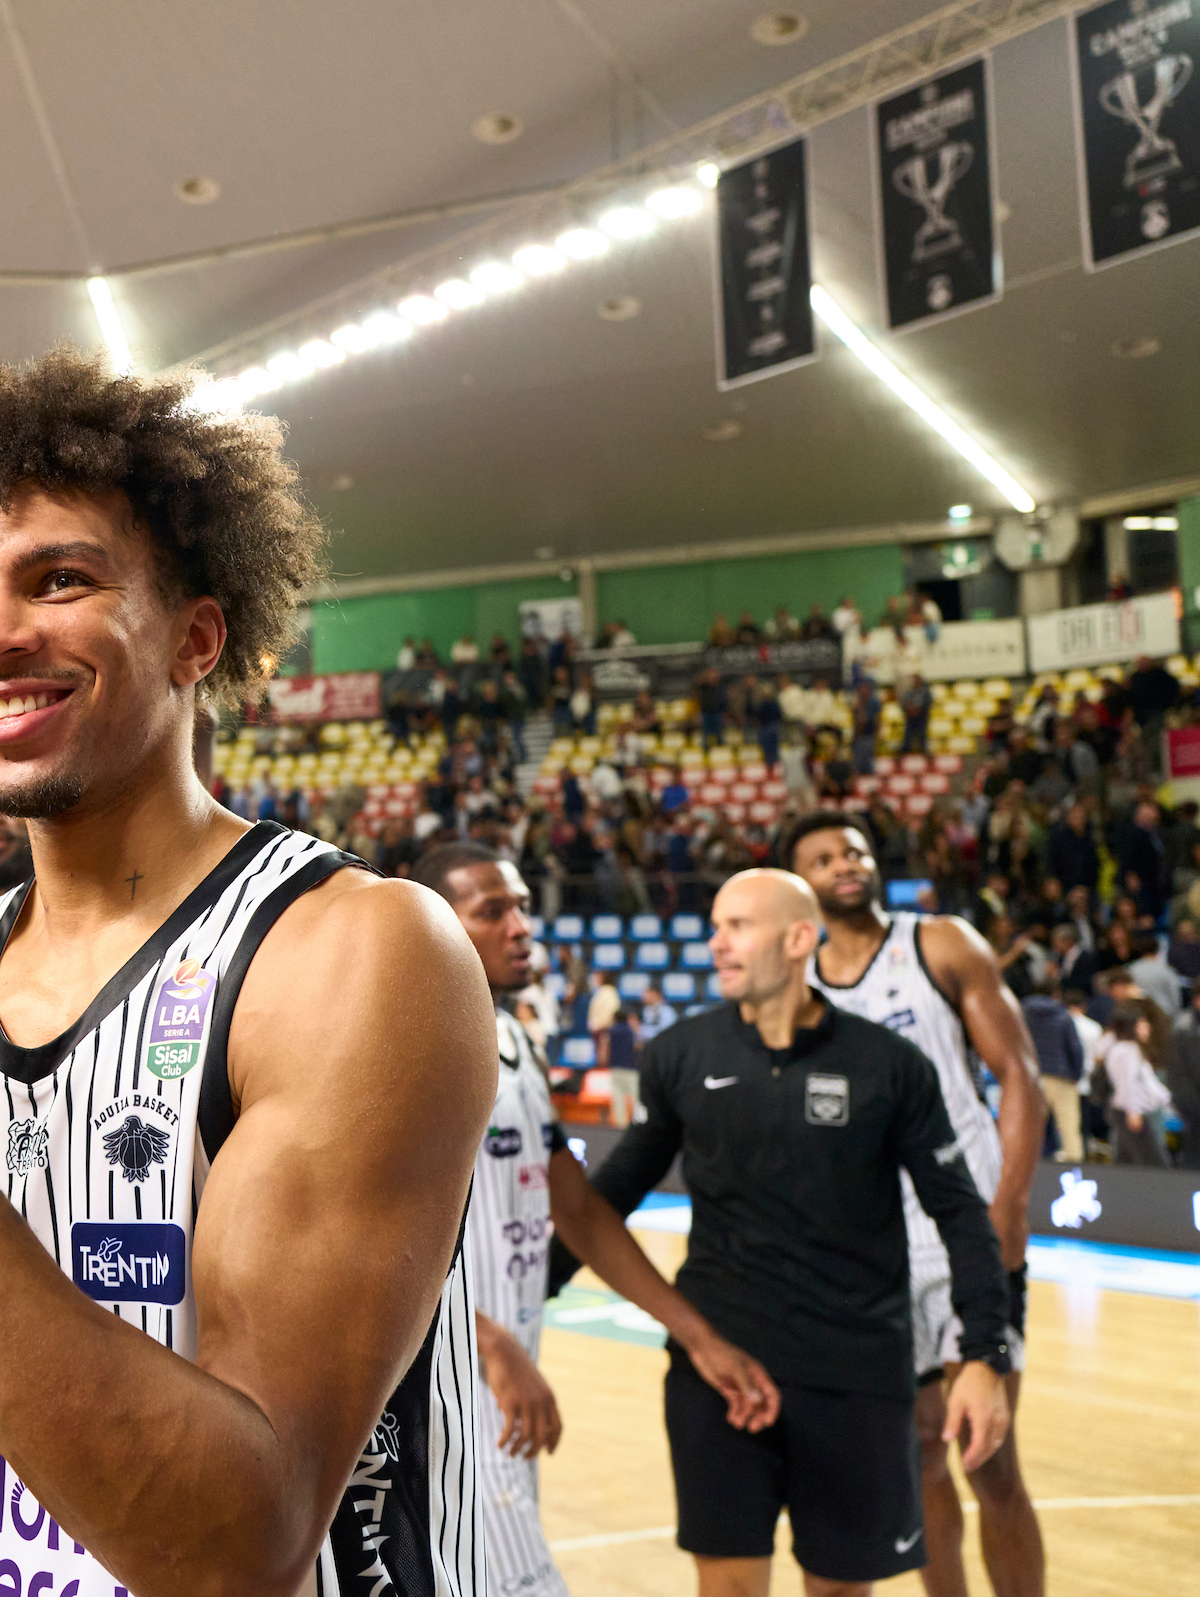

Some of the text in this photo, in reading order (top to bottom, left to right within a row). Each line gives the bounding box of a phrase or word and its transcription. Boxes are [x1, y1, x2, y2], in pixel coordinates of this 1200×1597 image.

[158, 1004, 200, 1026] LBA
[163, 1028, 190, 1038] SERIE A
[154, 1044, 193, 1065] Sisal
[161, 1064, 182, 1076] Club
[133, 1095, 179, 1126] BASKET
